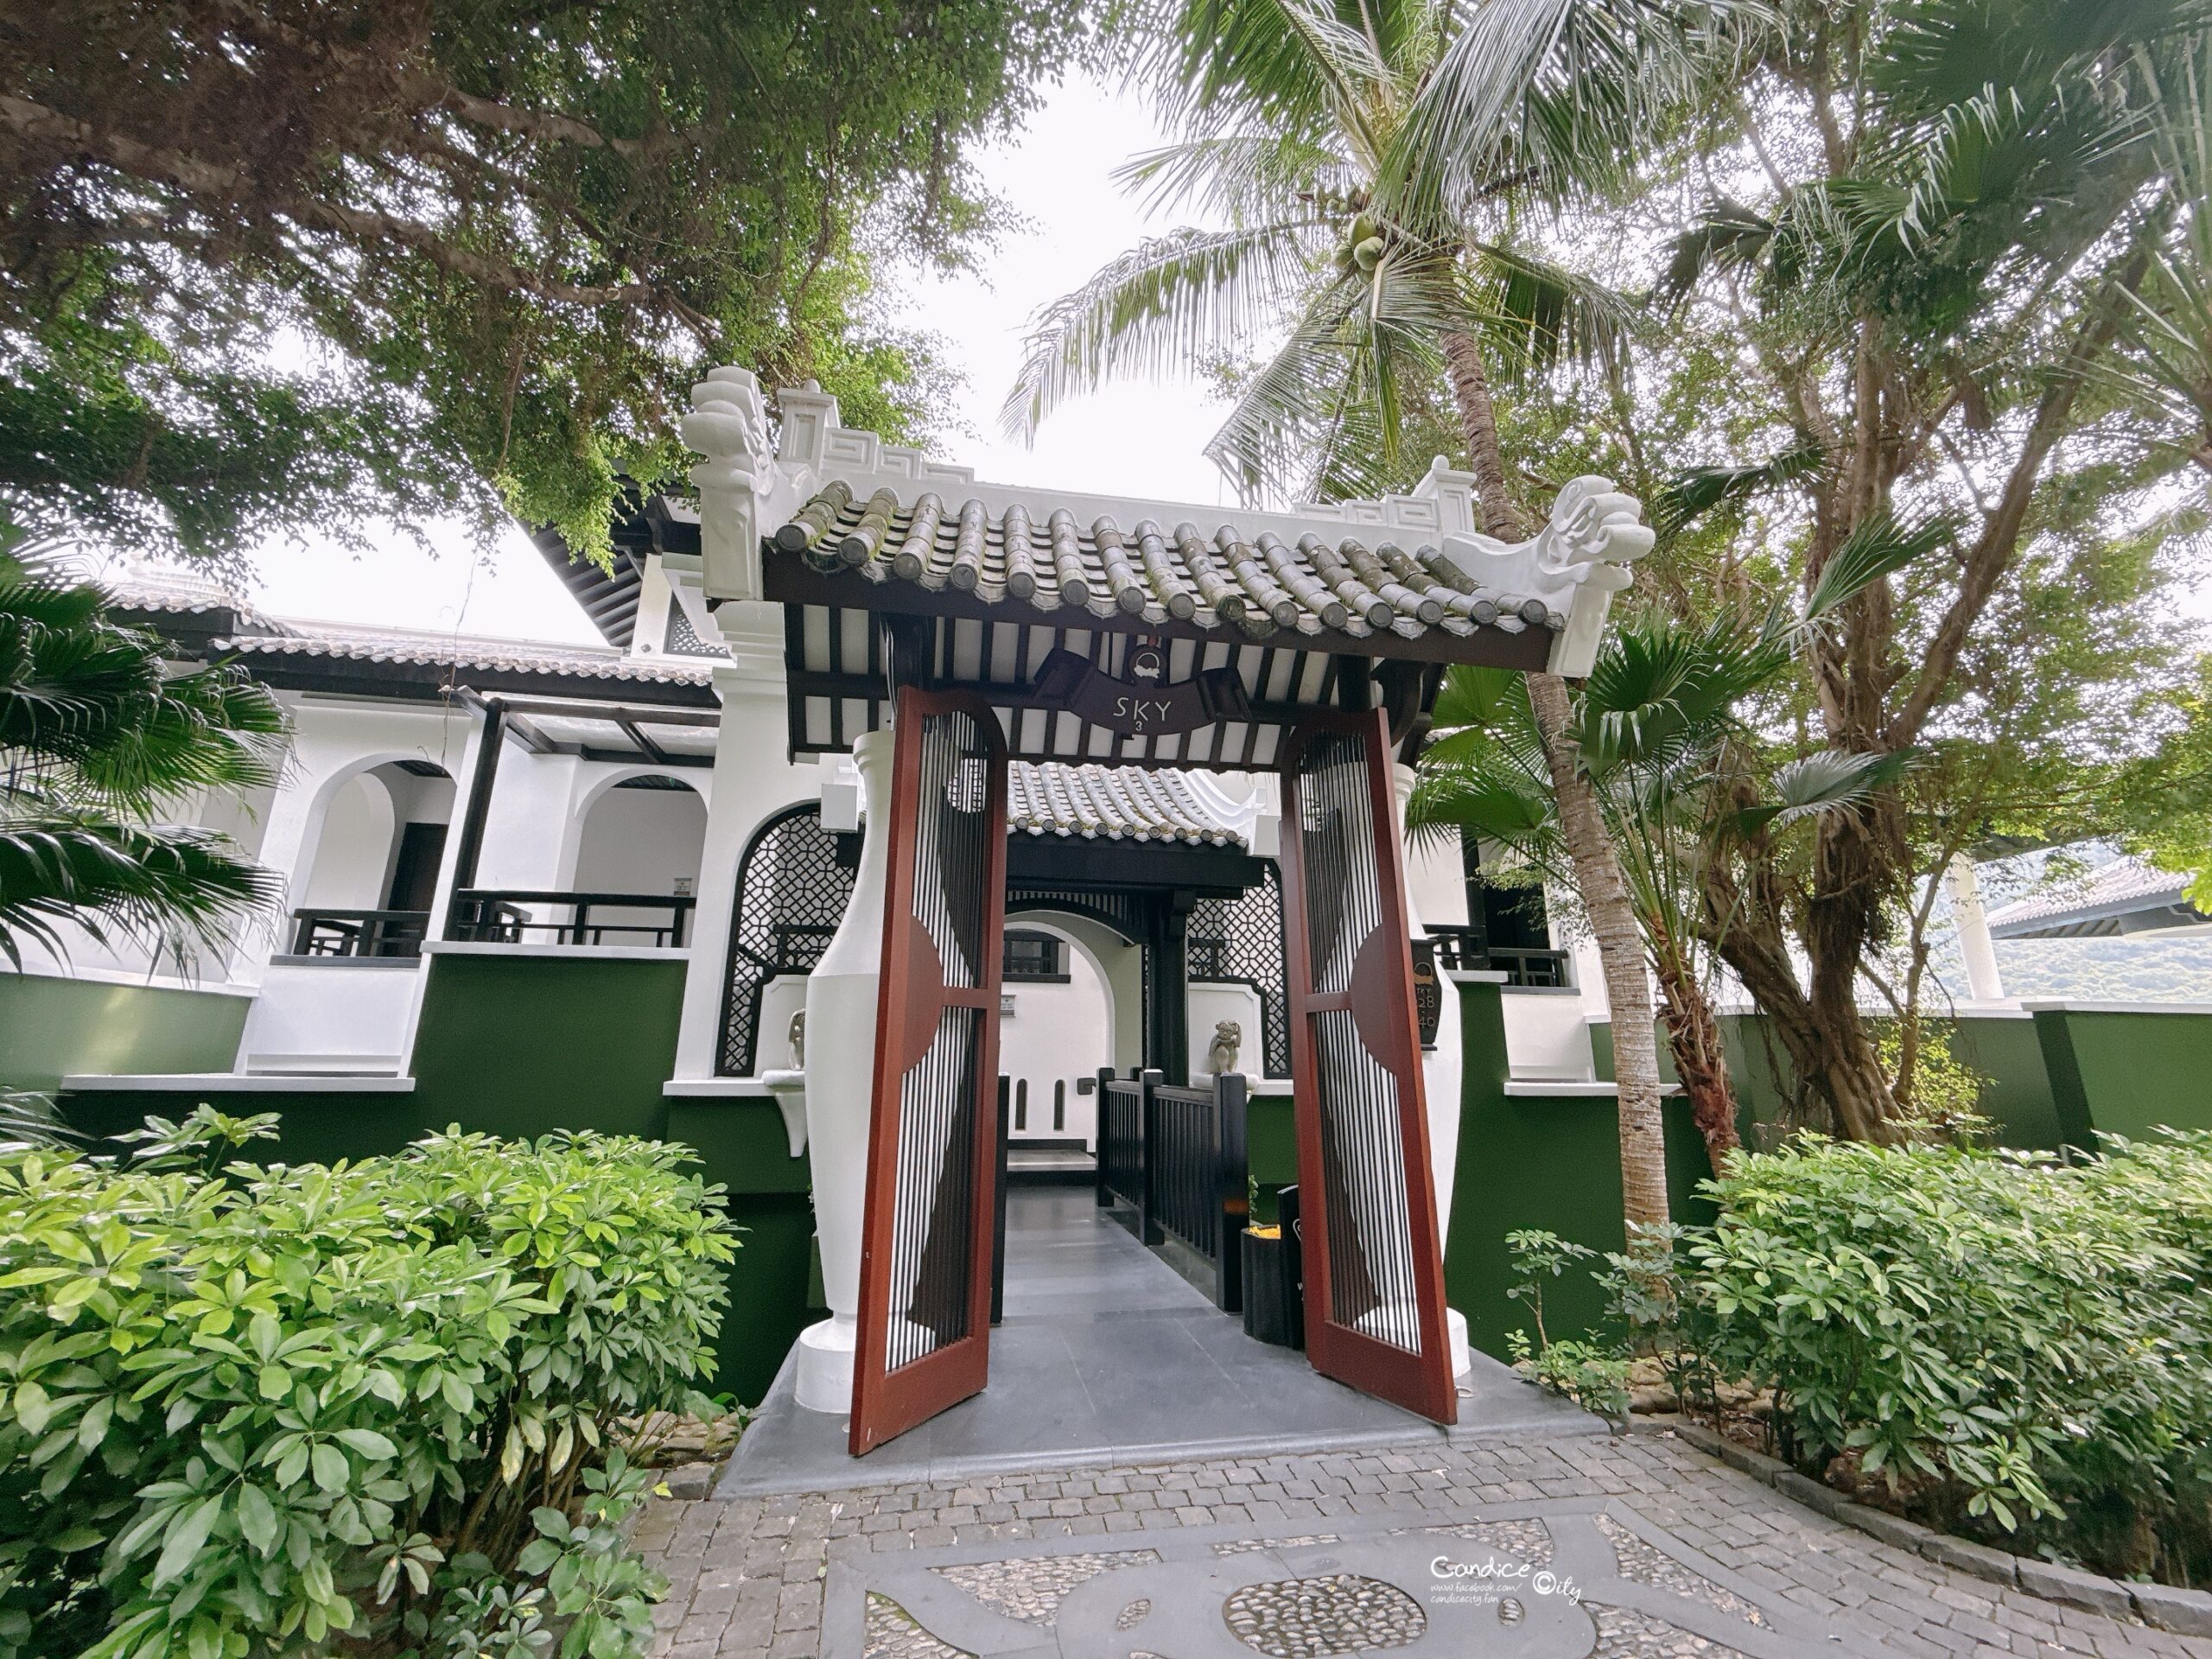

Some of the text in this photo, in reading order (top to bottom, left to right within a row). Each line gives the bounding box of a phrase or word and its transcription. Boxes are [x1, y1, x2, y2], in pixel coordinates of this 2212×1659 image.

[1113, 696, 1172, 721] SKY
[1135, 721, 1142, 732] 3
[1419, 1016, 1435, 1029] 40
